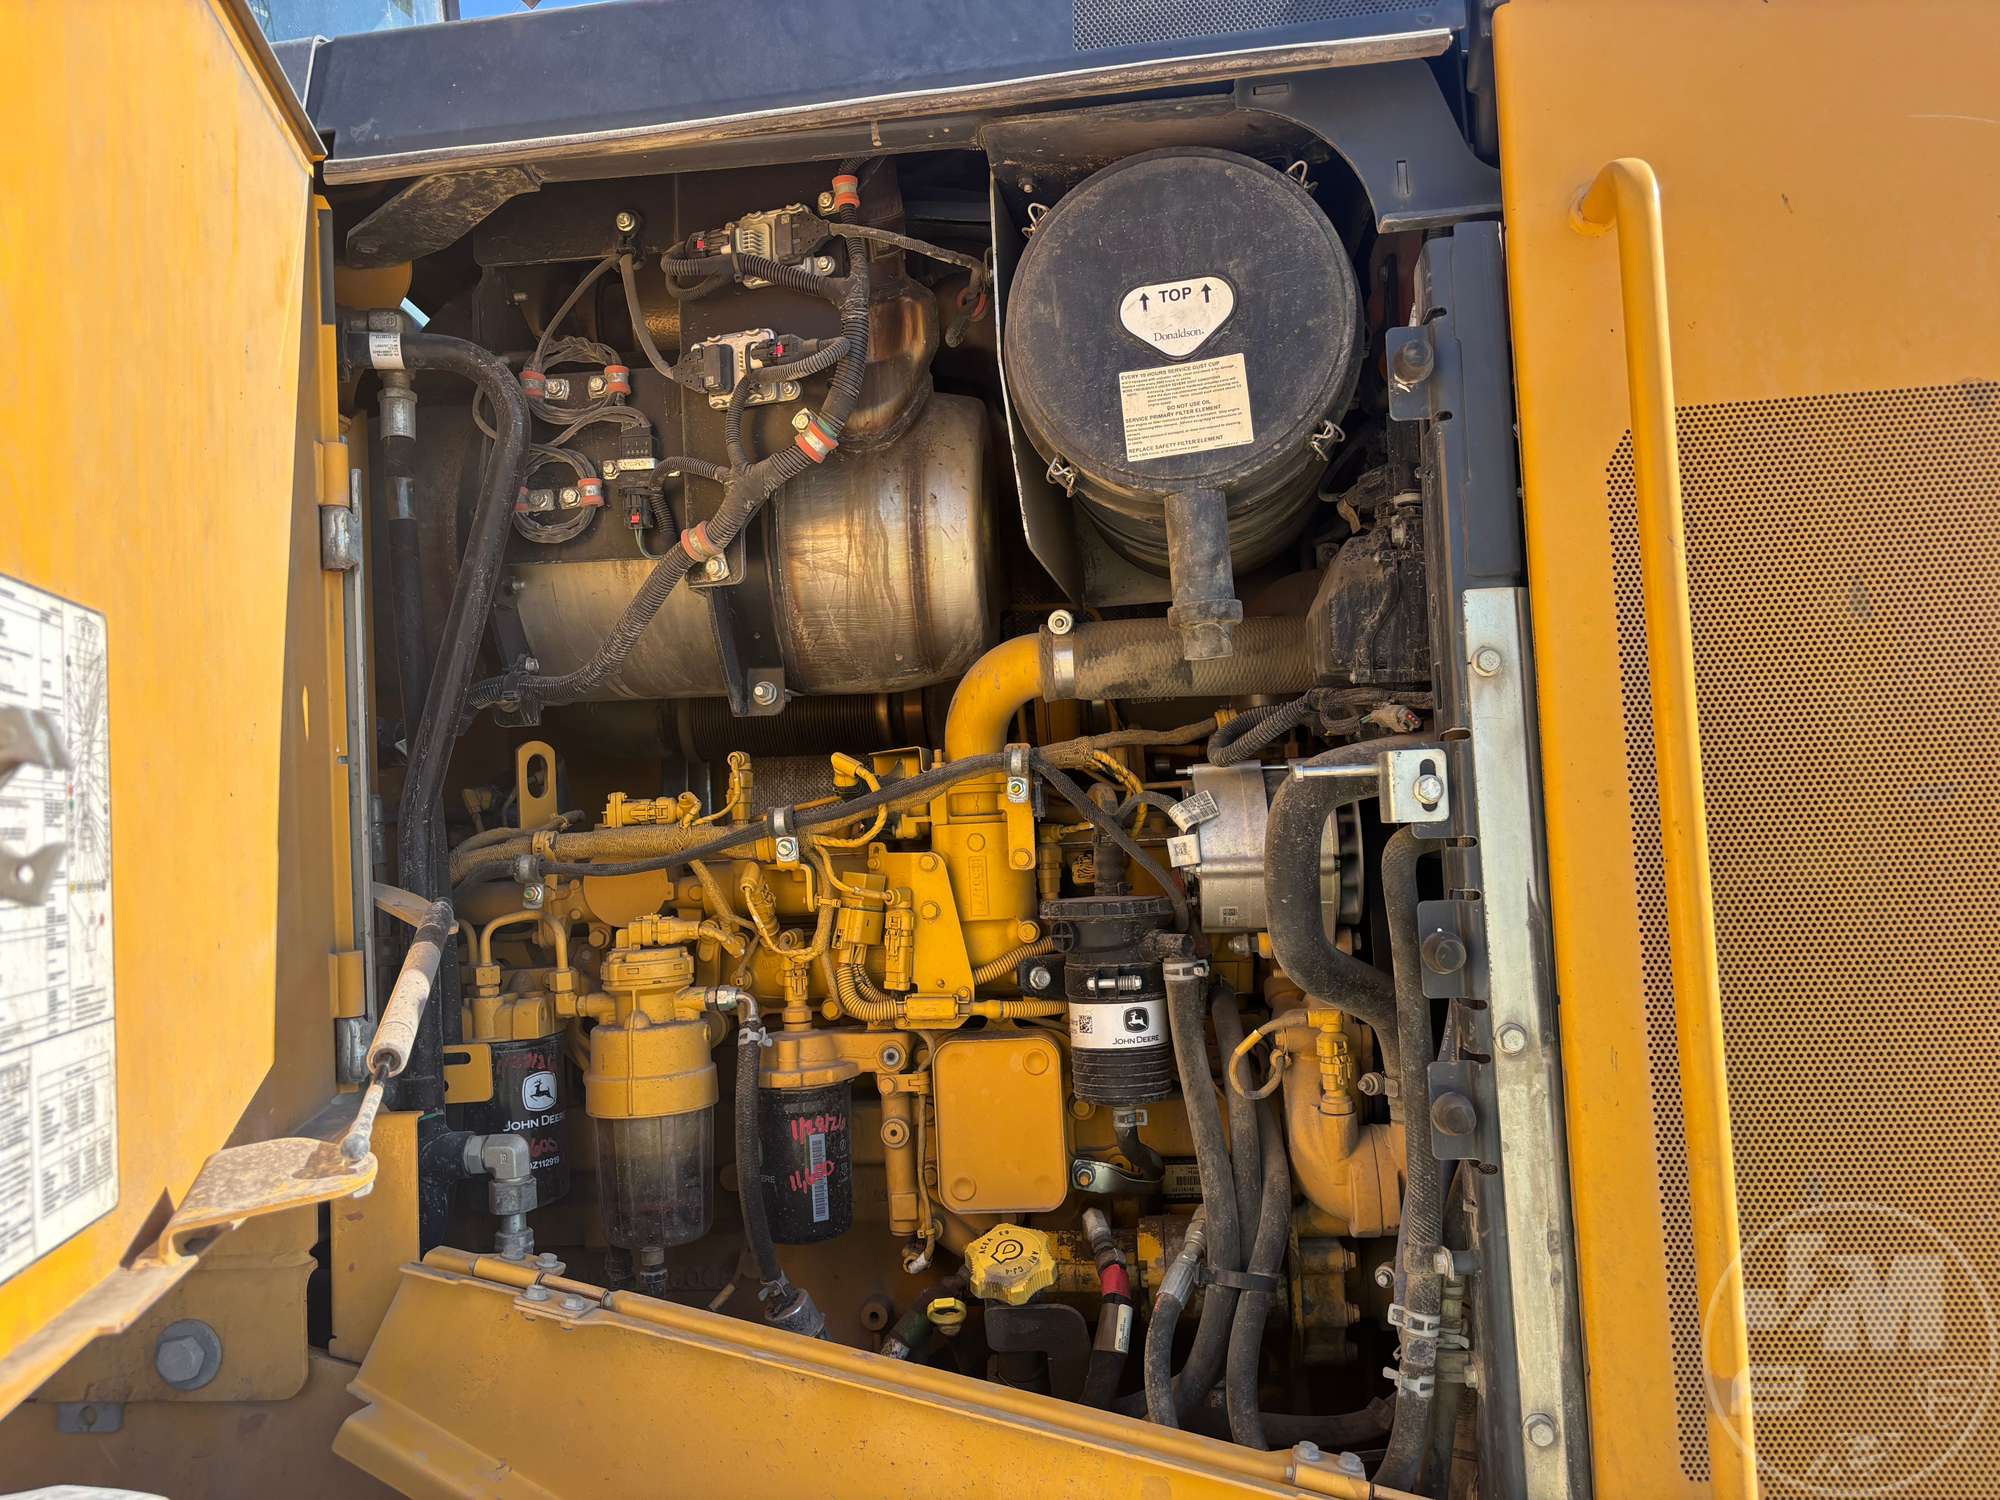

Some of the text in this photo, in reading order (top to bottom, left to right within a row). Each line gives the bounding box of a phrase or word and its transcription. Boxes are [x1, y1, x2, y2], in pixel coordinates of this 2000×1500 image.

[1158, 287, 1192, 303] TOP
[1167, 365, 1190, 373] SERVICE
[1125, 415, 1148, 424] SERVICE
[1149, 411, 1174, 420] PRIMARY
[1175, 408, 1193, 416] FILTER
[1195, 404, 1221, 412] ELEMENT
[1128, 446, 1153, 454] REPLACE
[1154, 442, 1176, 450] SAFETY
[1177, 438, 1196, 446] FILTER
[1197, 434, 1223, 443] ELEMENT
[1112, 1034, 1160, 1045] JOHN DEERE
[502, 1118, 539, 1132] JOHN
[1028, 1250, 1040, 1266] API
